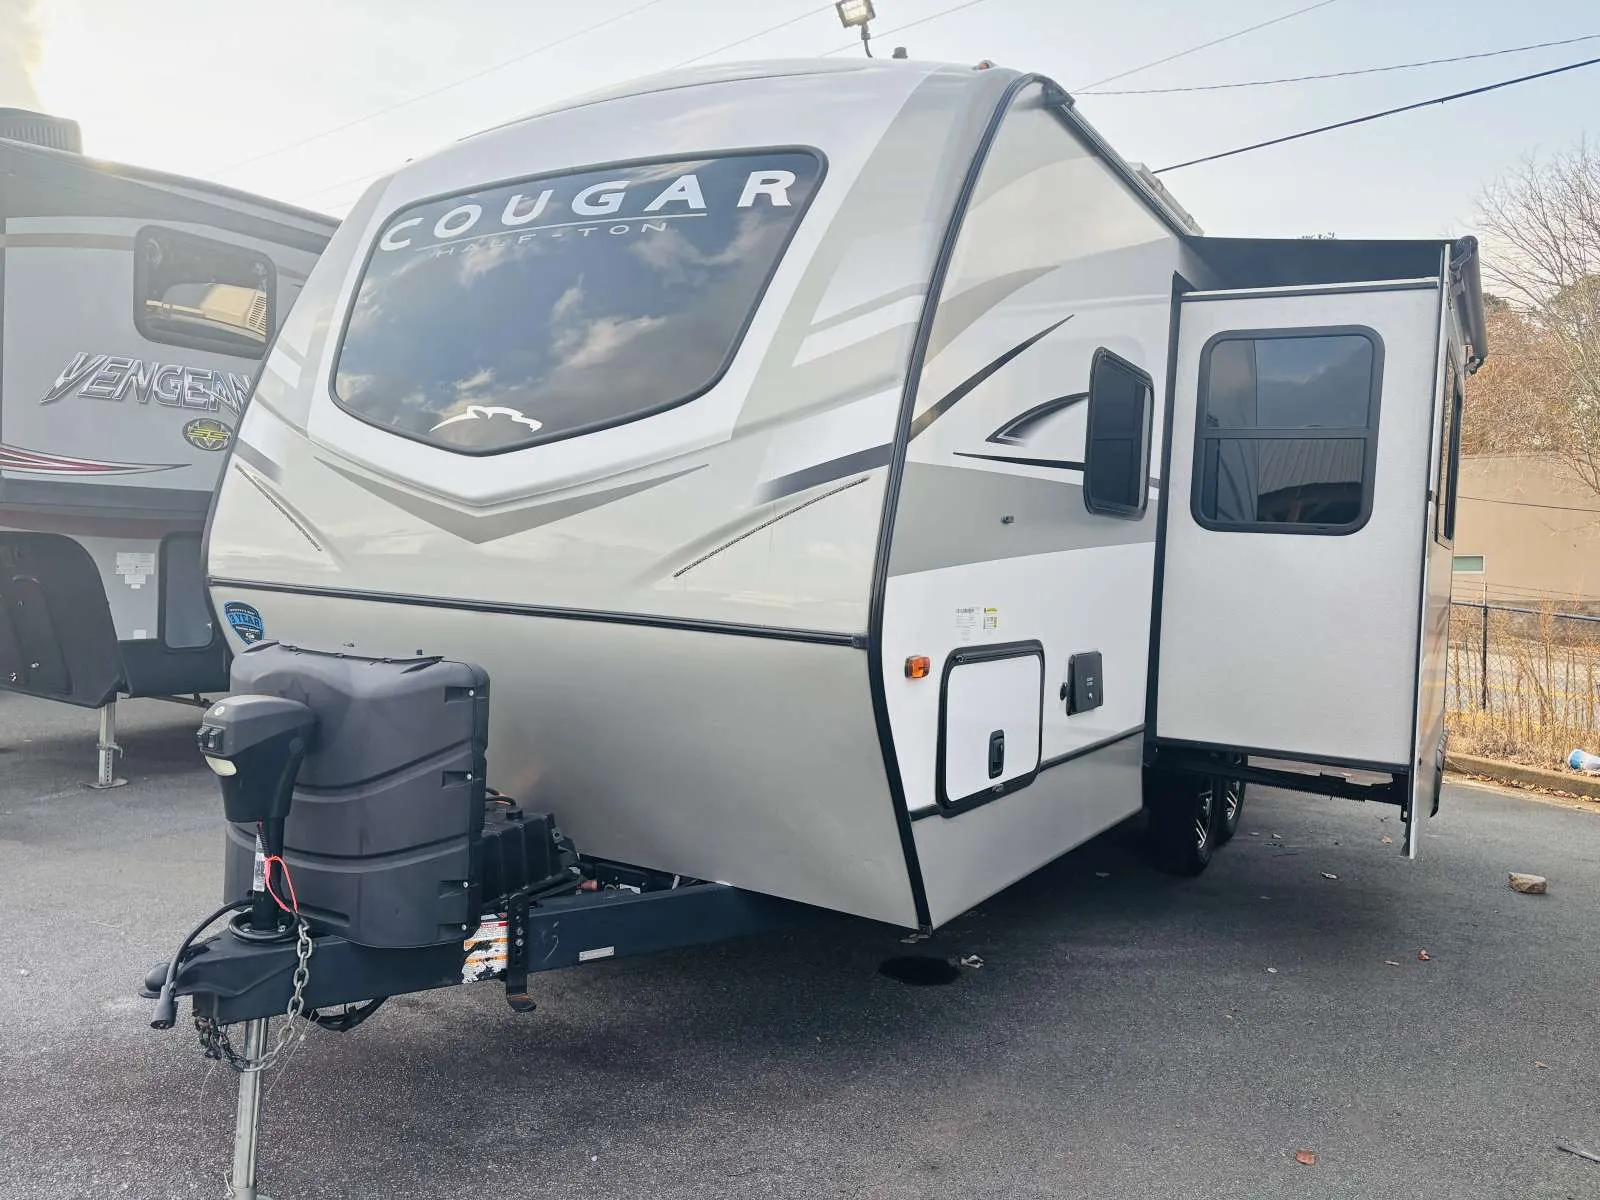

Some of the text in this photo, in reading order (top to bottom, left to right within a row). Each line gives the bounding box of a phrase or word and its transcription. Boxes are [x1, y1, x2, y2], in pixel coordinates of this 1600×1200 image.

[380, 169, 797, 252] COUGAR
[435, 221, 668, 258] HALF-TON
[235, 613, 261, 628] YEAR
